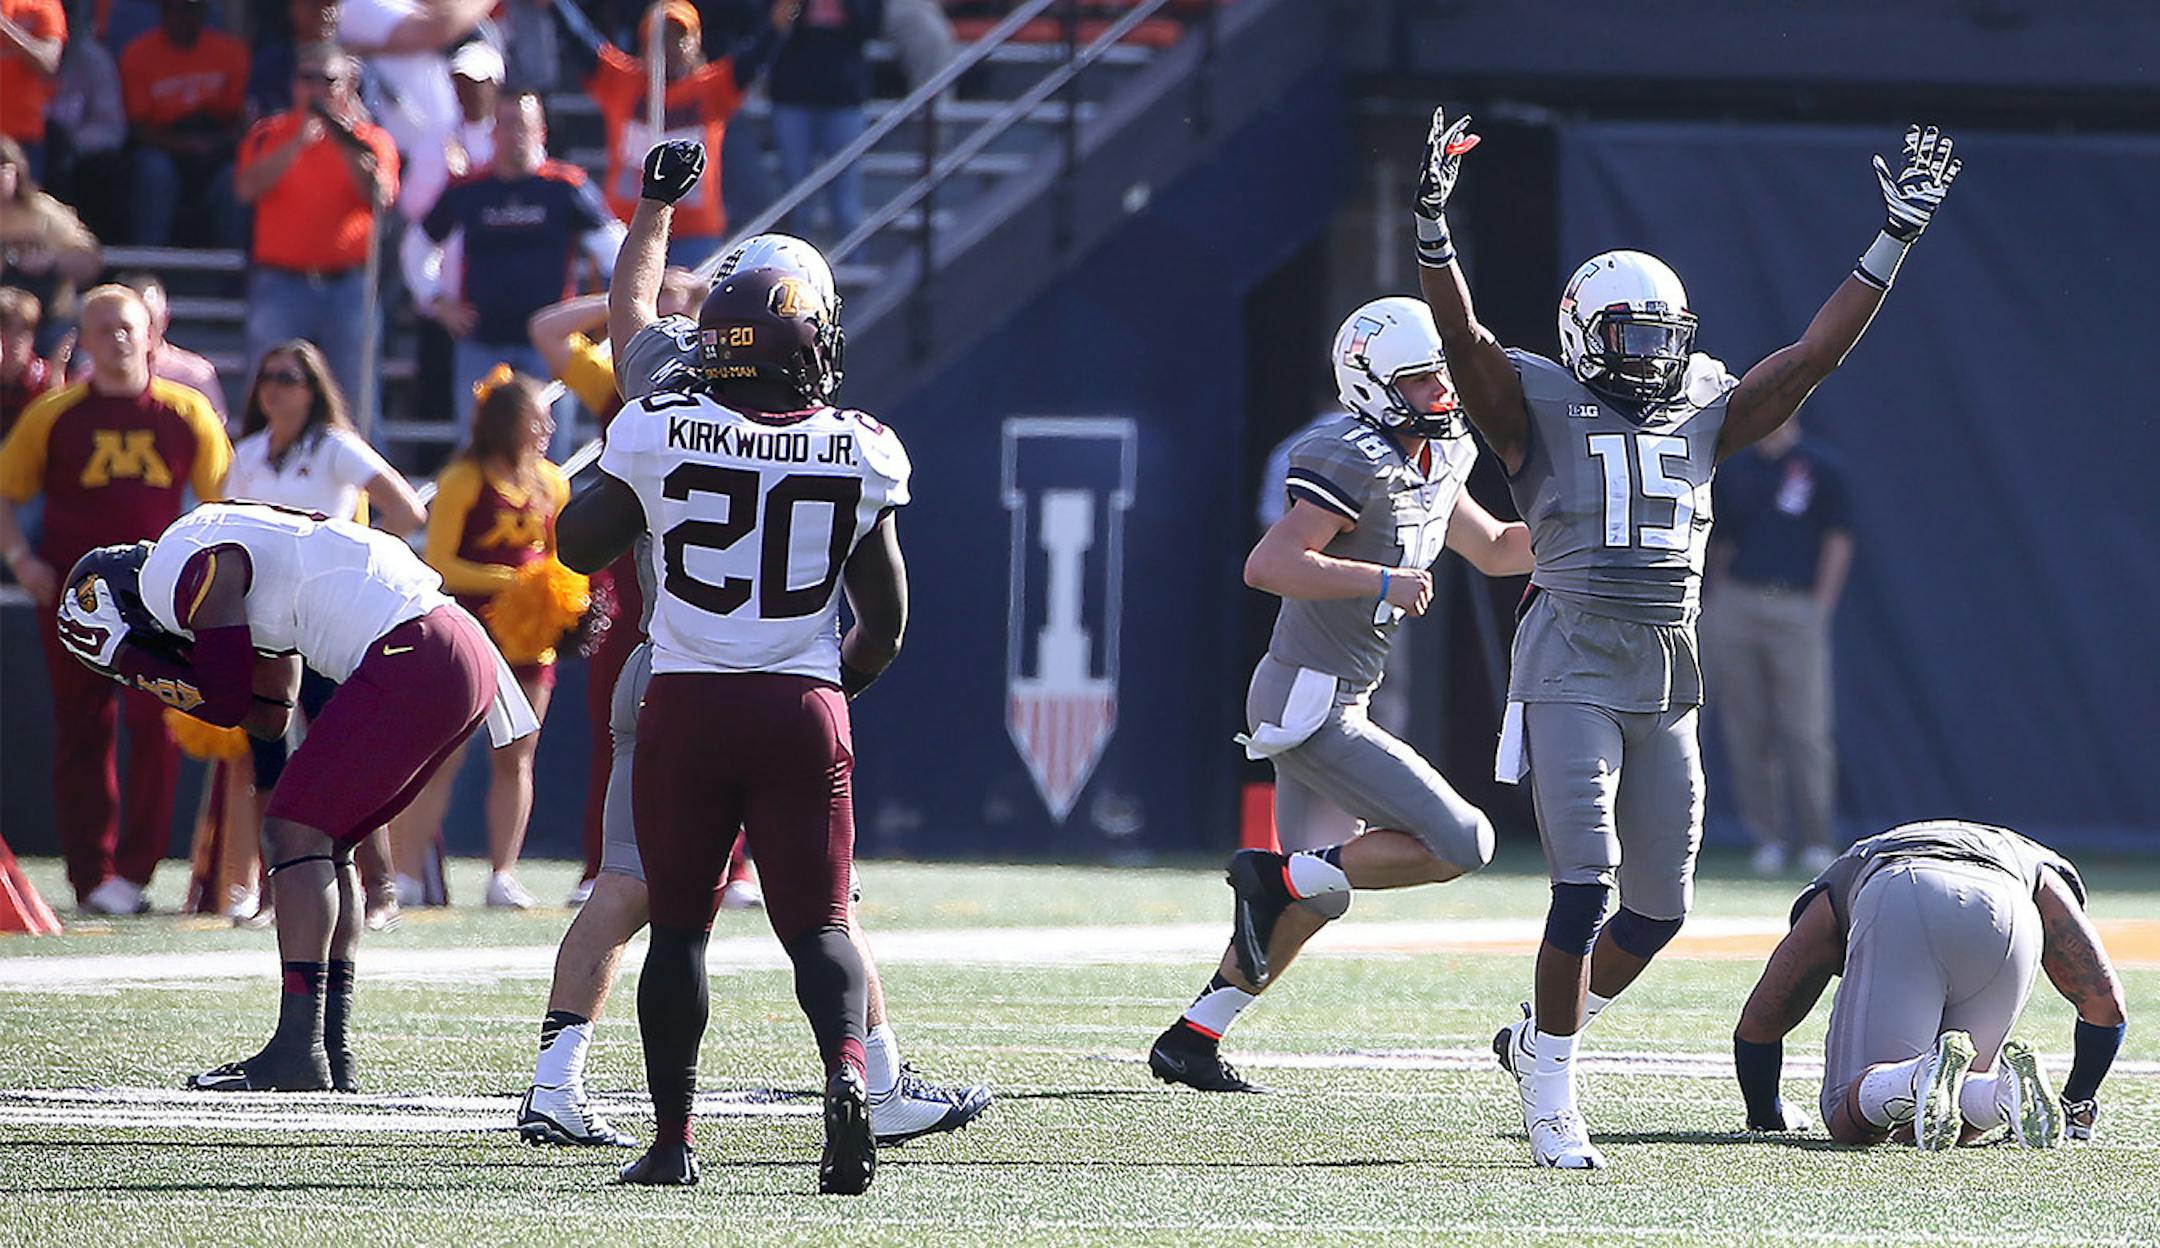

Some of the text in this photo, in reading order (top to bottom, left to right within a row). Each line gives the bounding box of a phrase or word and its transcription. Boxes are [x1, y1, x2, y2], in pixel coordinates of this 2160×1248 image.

[730, 327, 754, 346] 20
[1343, 316, 1385, 371] I
[81, 430, 172, 488] M
[668, 416, 808, 463] KIRKWOOD
[818, 434, 858, 466] JR.
[1586, 431, 1696, 553] 15
[662, 462, 863, 620] 20
